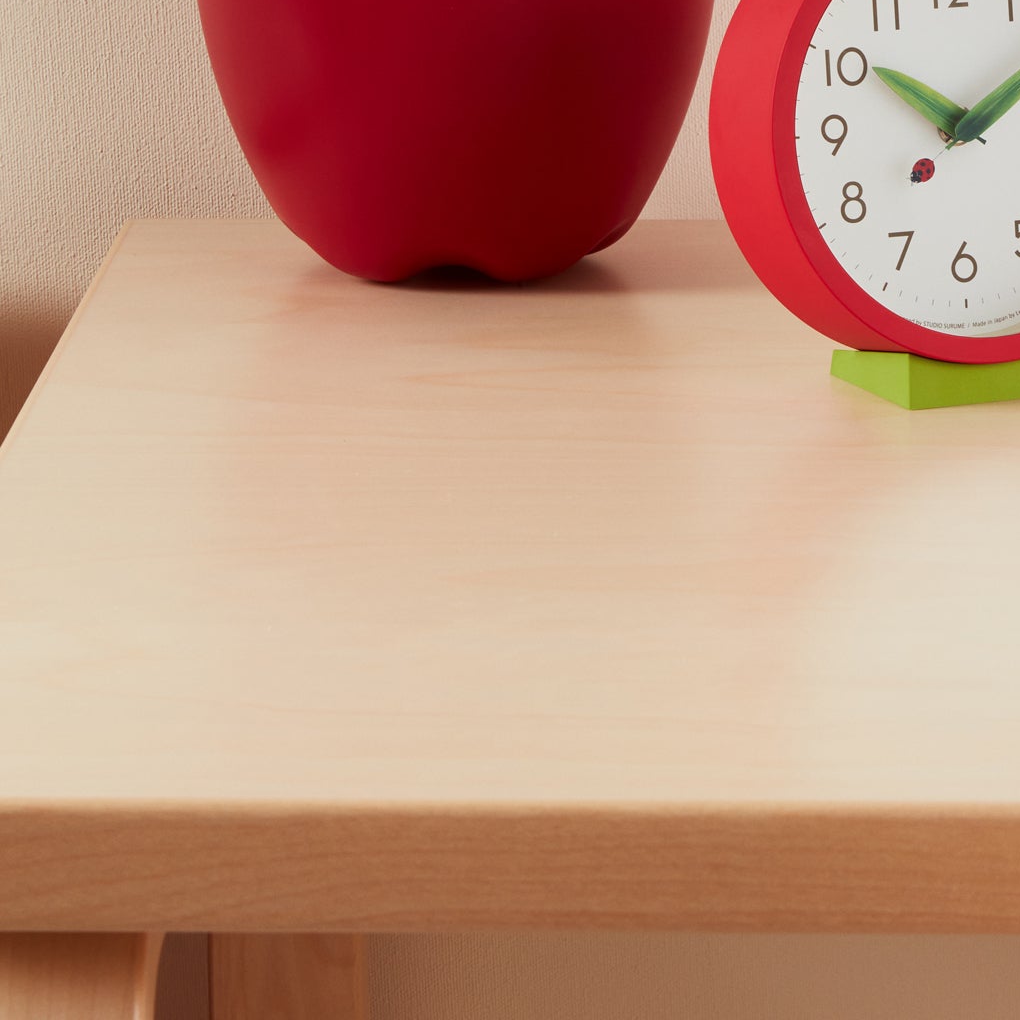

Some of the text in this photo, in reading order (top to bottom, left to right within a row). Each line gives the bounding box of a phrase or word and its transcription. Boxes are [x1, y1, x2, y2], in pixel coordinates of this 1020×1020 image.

[824, 46, 868, 87] 10
[820, 114, 848, 157] 9
[840, 180, 867, 224] 8
[887, 230, 915, 271] 7
[950, 240, 978, 283] 6
[993, 315, 1009, 324] Japan
